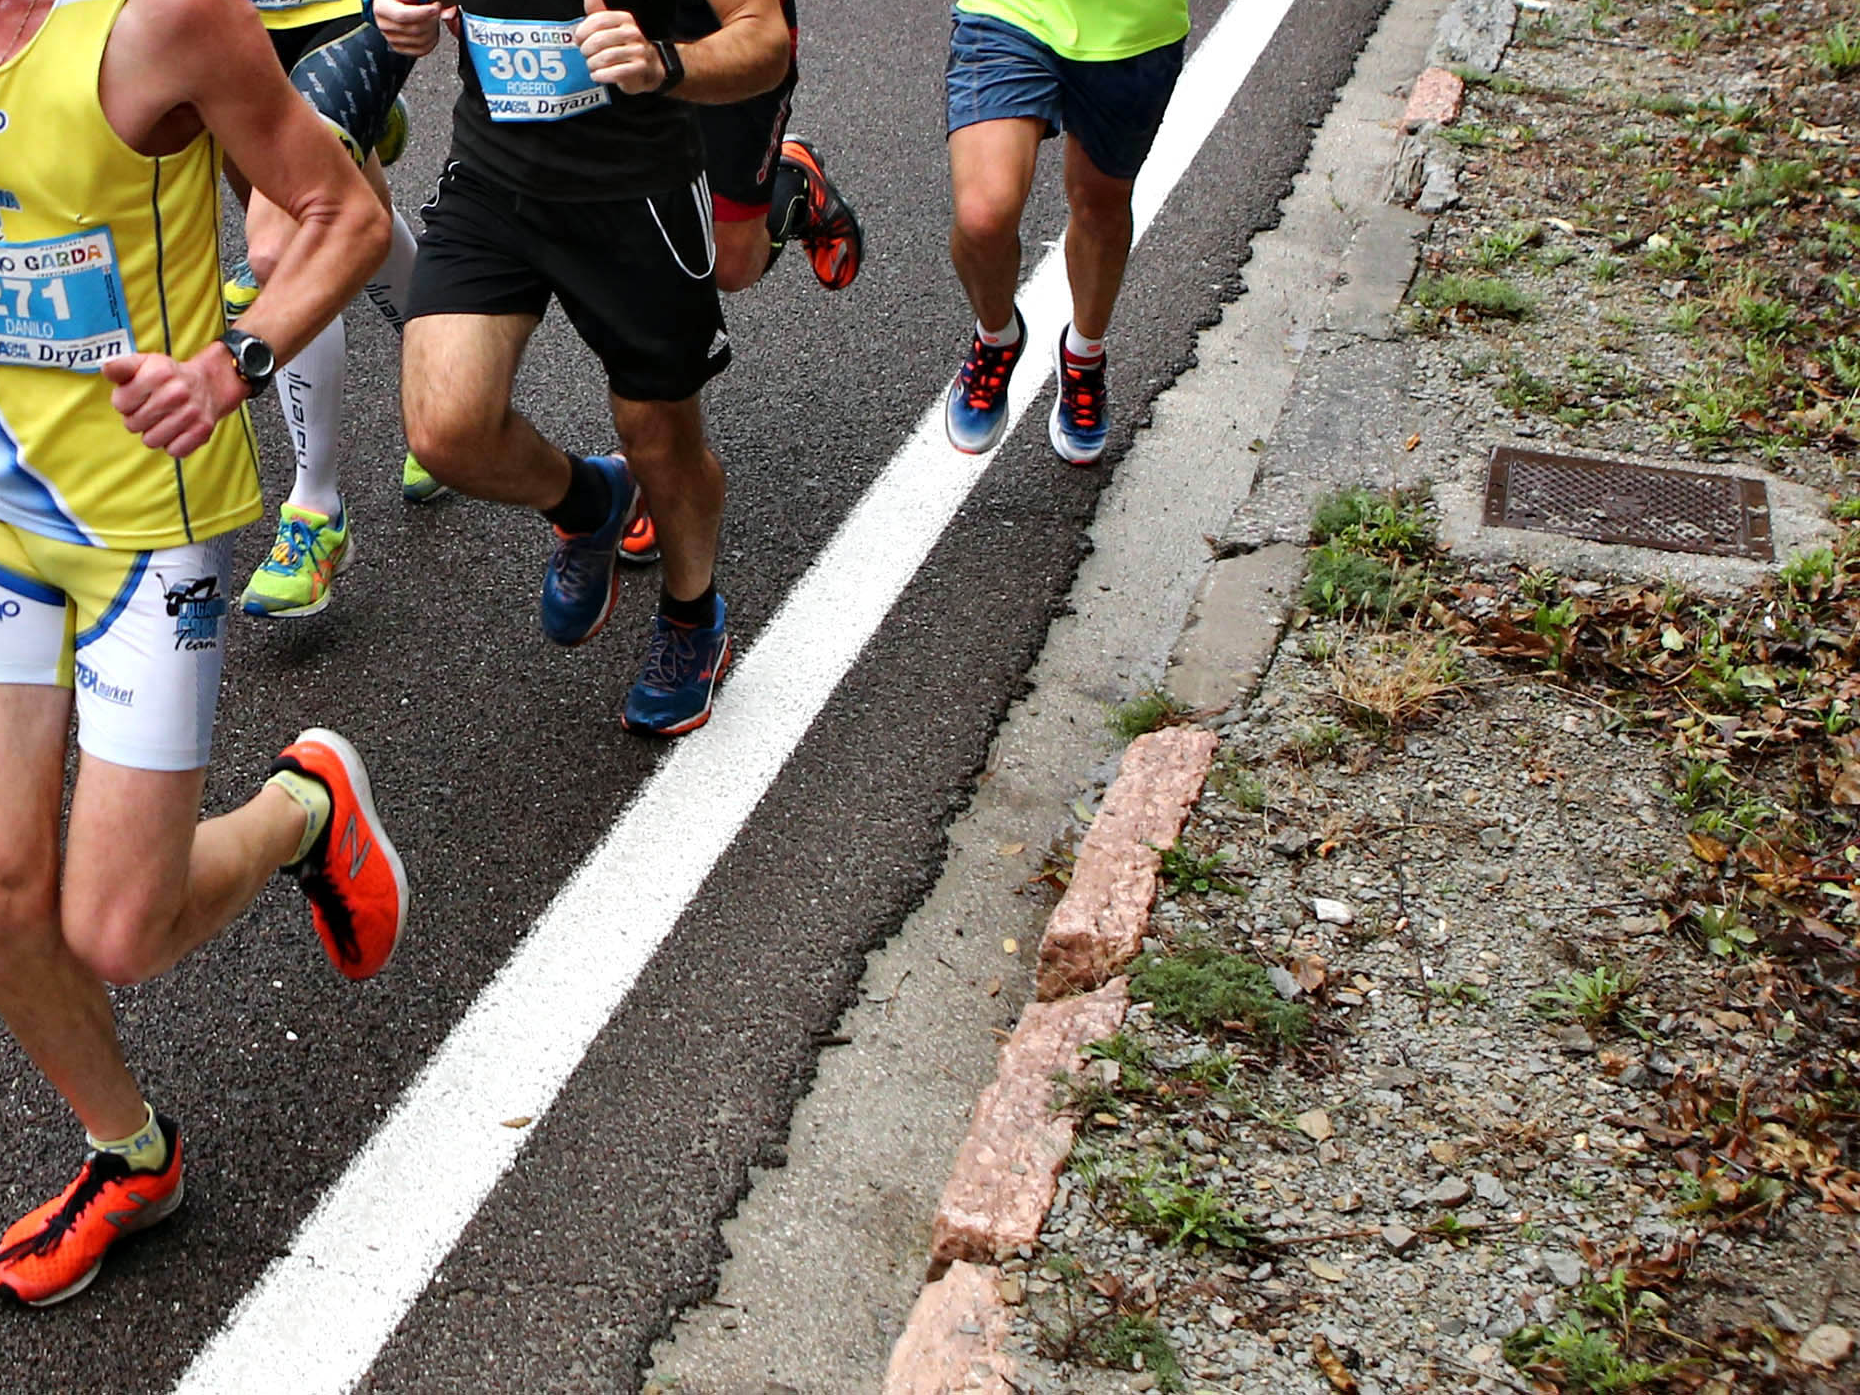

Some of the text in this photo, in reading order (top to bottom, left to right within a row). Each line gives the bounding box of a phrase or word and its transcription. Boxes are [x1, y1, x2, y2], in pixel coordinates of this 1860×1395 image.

[469, 23, 574, 48] TRENTINO GARD
[487, 49, 568, 82] 305
[506, 82, 557, 96] ROBERTO
[536, 92, 601, 116] Dryarn
[24, 244, 104, 272] GARDA
[5, 317, 55, 339] DANILO
[39, 339, 123, 369] Dryarn
[173, 627, 218, 652] Team
